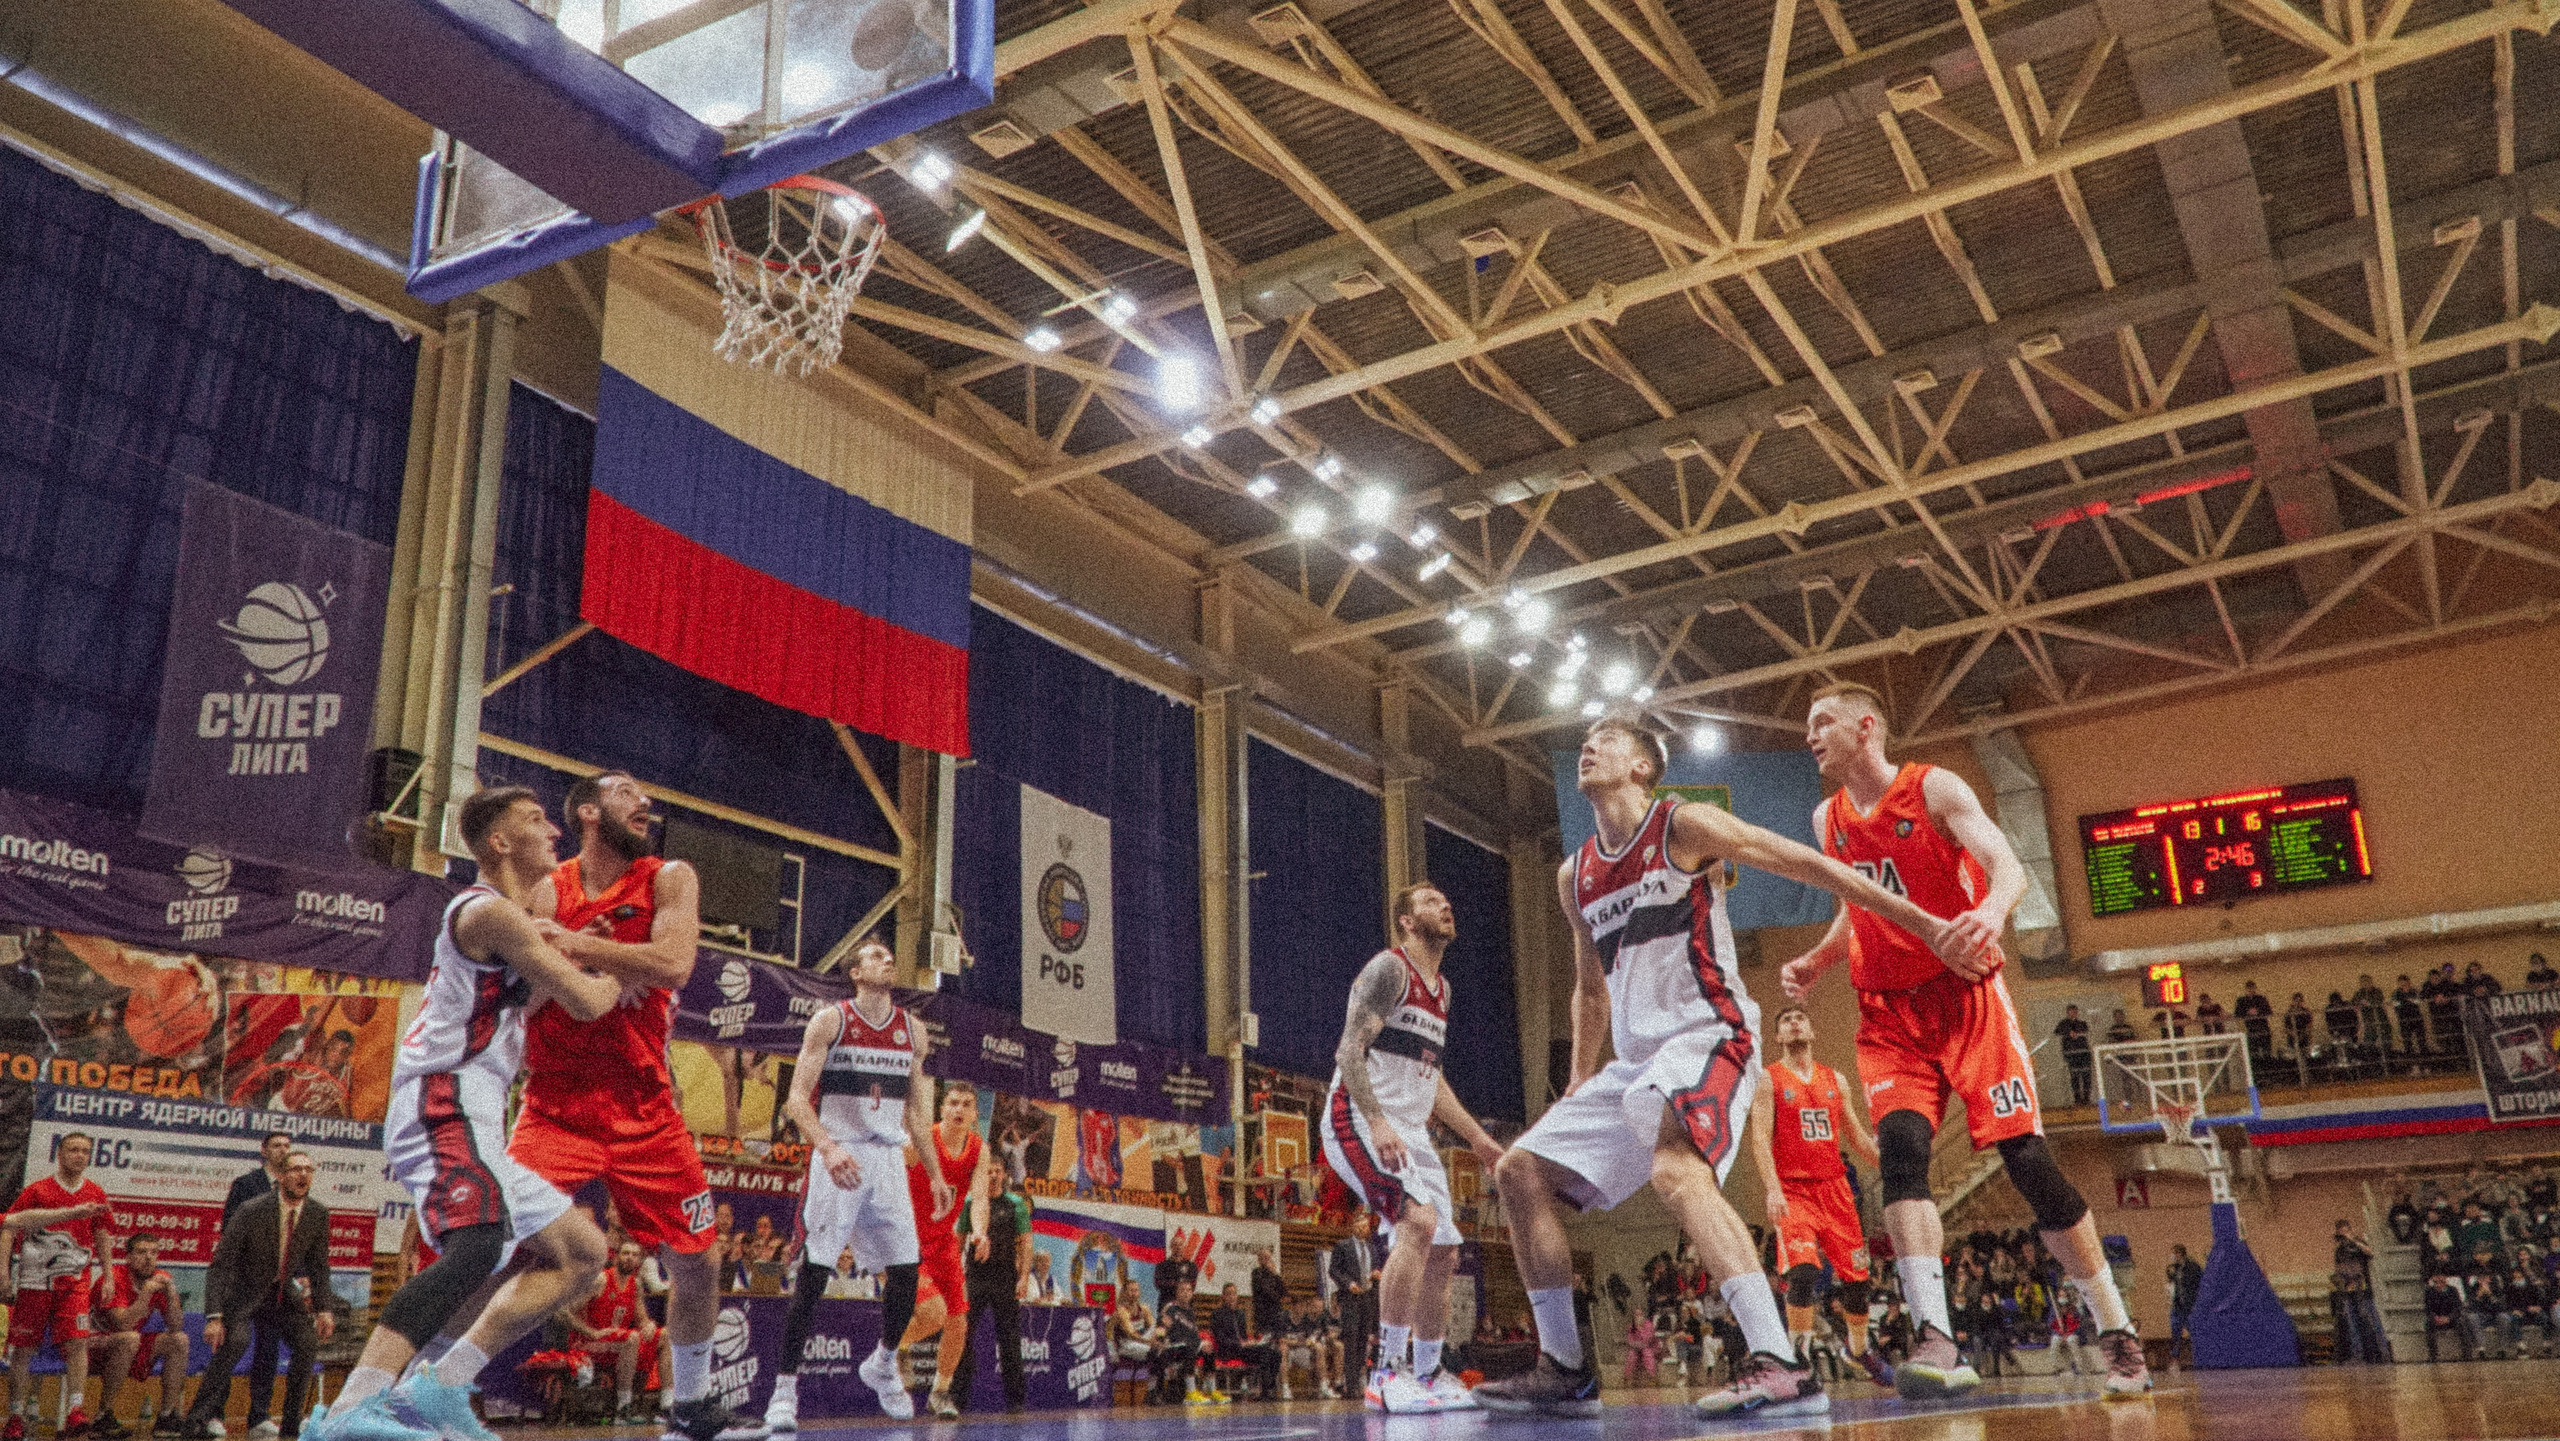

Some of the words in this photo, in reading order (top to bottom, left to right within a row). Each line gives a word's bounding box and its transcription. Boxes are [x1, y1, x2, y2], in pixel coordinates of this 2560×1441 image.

[197, 692, 342, 738] СУПЕР
[227, 743, 309, 775] ЛИГА
[2183, 820, 2201, 840] 13
[2243, 811, 2262, 831] 16
[0, 834, 109, 875] molten
[2205, 842, 2255, 872] 2:46
[166, 896, 240, 925] СУПЕР
[295, 890, 385, 923] molten
[180, 923, 224, 942] ЛИГА
[1040, 954, 1085, 990] РФБ
[2163, 980, 2185, 1003] 10
[709, 1003, 755, 1026] СУПЕР
[983, 1034, 1025, 1058] molten
[52, 1058, 203, 1099] ПОБЕДА
[1100, 1061, 1138, 1081] molten
[1989, 1077, 2031, 1116] 34
[54, 1092, 135, 1118] ЦЕНТР
[139, 1101, 246, 1129] ЯДЕРНОЙ
[251, 1112, 371, 1141] МЕДИЦИНЫ
[1800, 1108, 1832, 1141] 55
[737, 1172, 784, 1192] КЛУБ
[1023, 1176, 1077, 1199] СПОРТ
[136, 1213, 200, 1230] 50-69-31
[803, 1333, 851, 1361] olten
[709, 1356, 759, 1399] СУПЕР
[1067, 1354, 1106, 1391] СУПЕР
